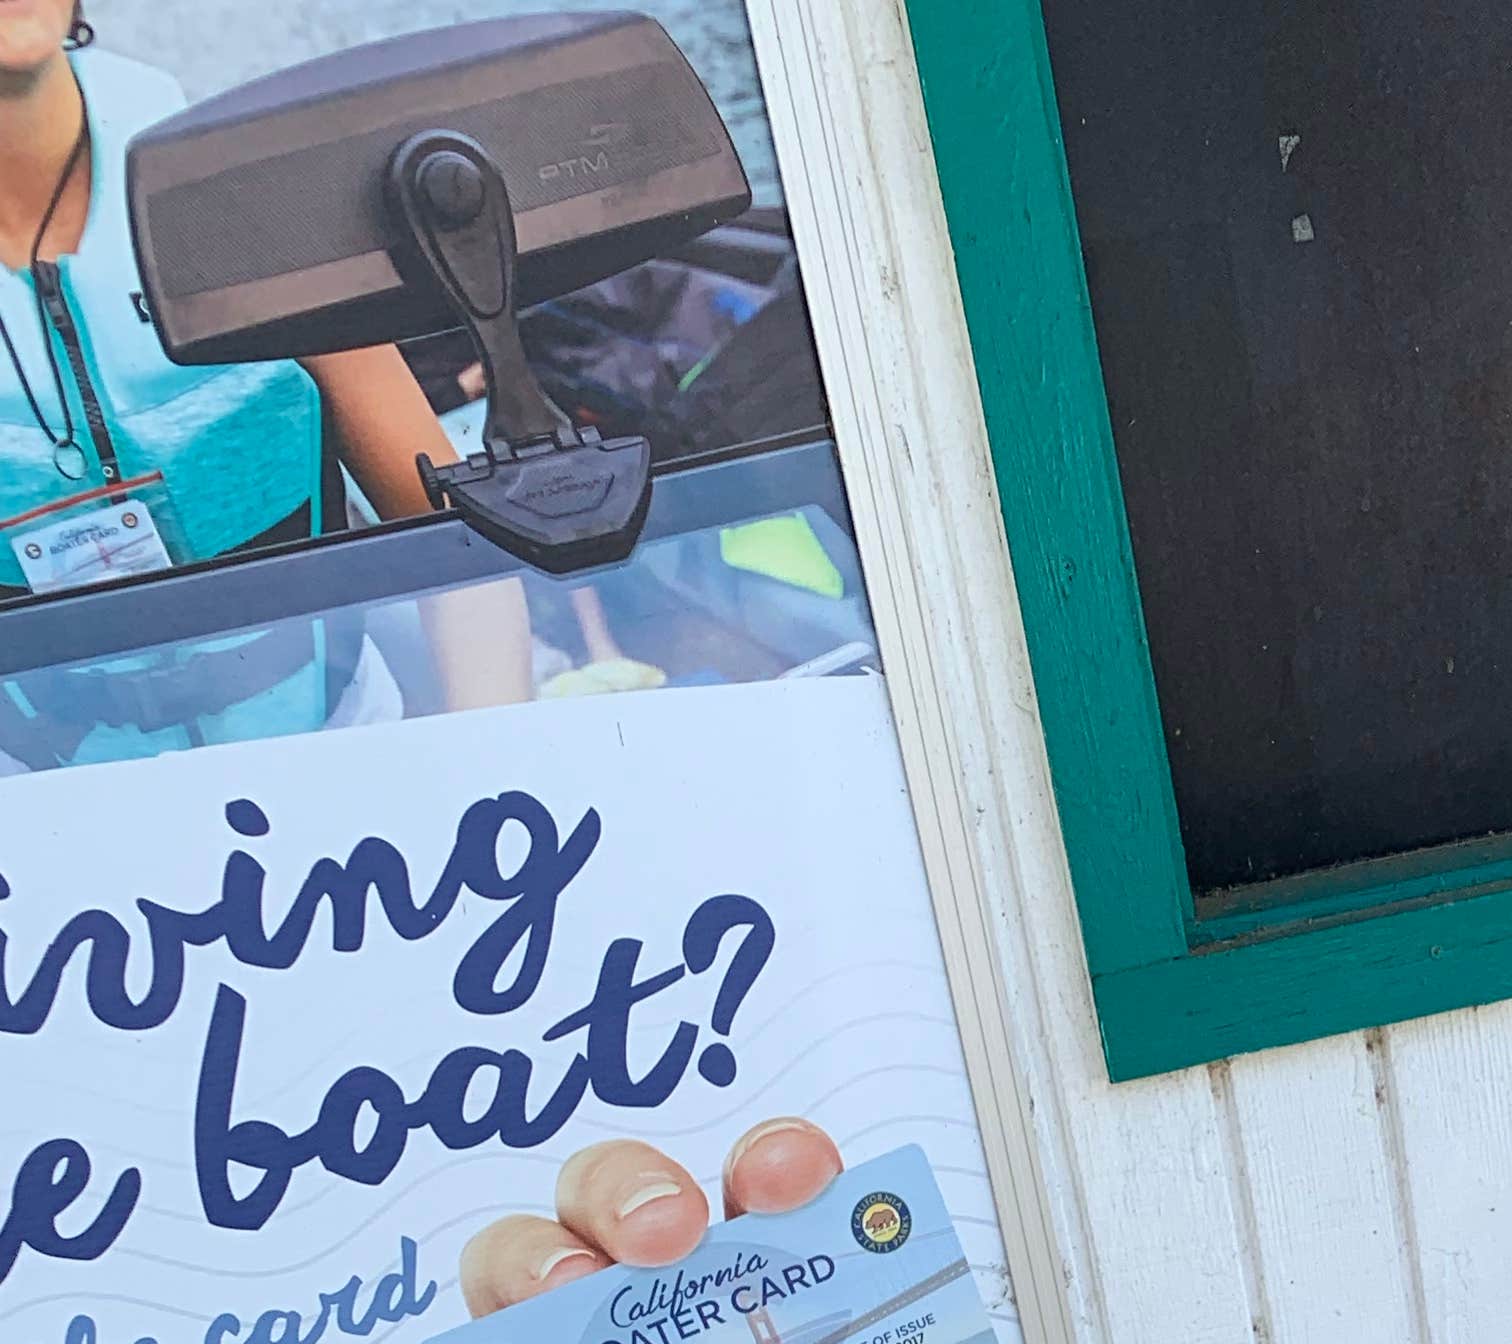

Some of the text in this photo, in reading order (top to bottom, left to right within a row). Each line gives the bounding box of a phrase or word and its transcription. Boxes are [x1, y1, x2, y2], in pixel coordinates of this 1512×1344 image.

[195, 893, 775, 1230] boat?
[610, 1252, 768, 1328] California
[730, 1254, 835, 1314] CARD
[895, 1313, 936, 1338] ISSUE
